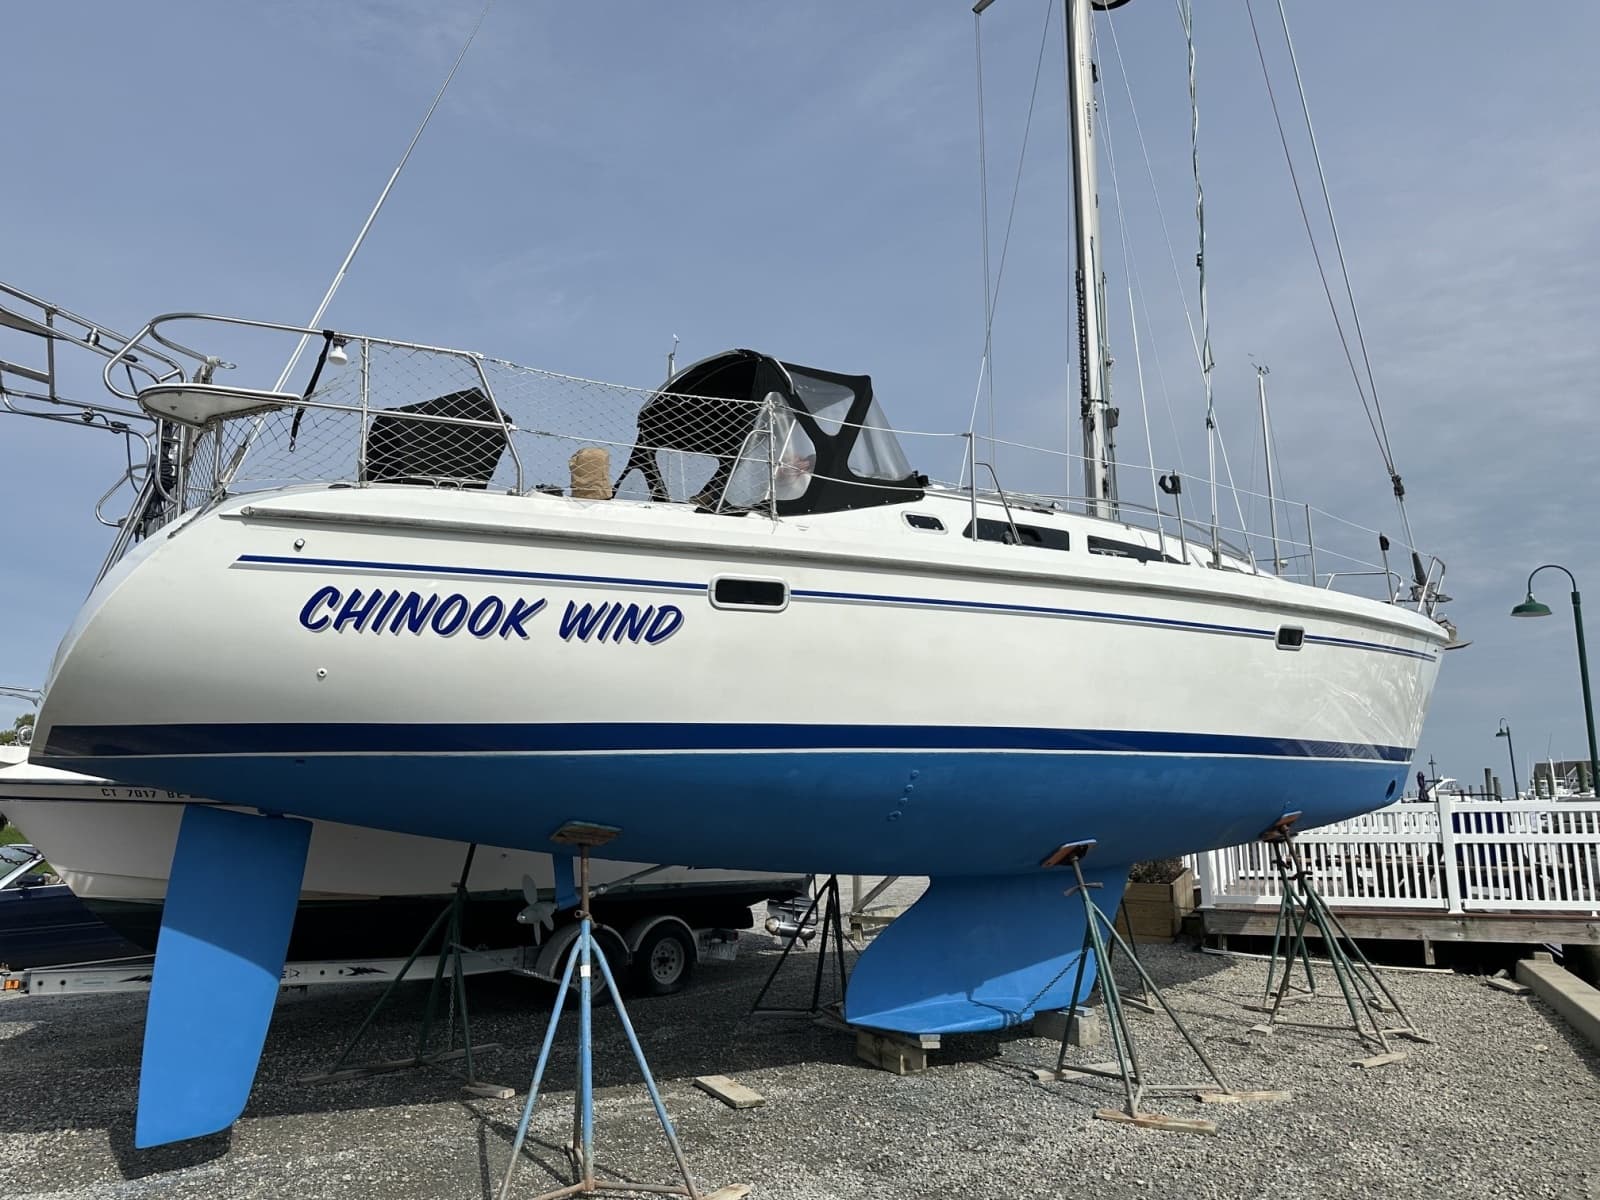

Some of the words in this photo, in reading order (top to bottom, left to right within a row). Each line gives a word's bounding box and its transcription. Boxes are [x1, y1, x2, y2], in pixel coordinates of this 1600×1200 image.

[299, 585, 547, 640] CHINOOK
[558, 600, 685, 646] WIND
[101, 788, 118, 797] CT
[127, 789, 157, 798] 7017
